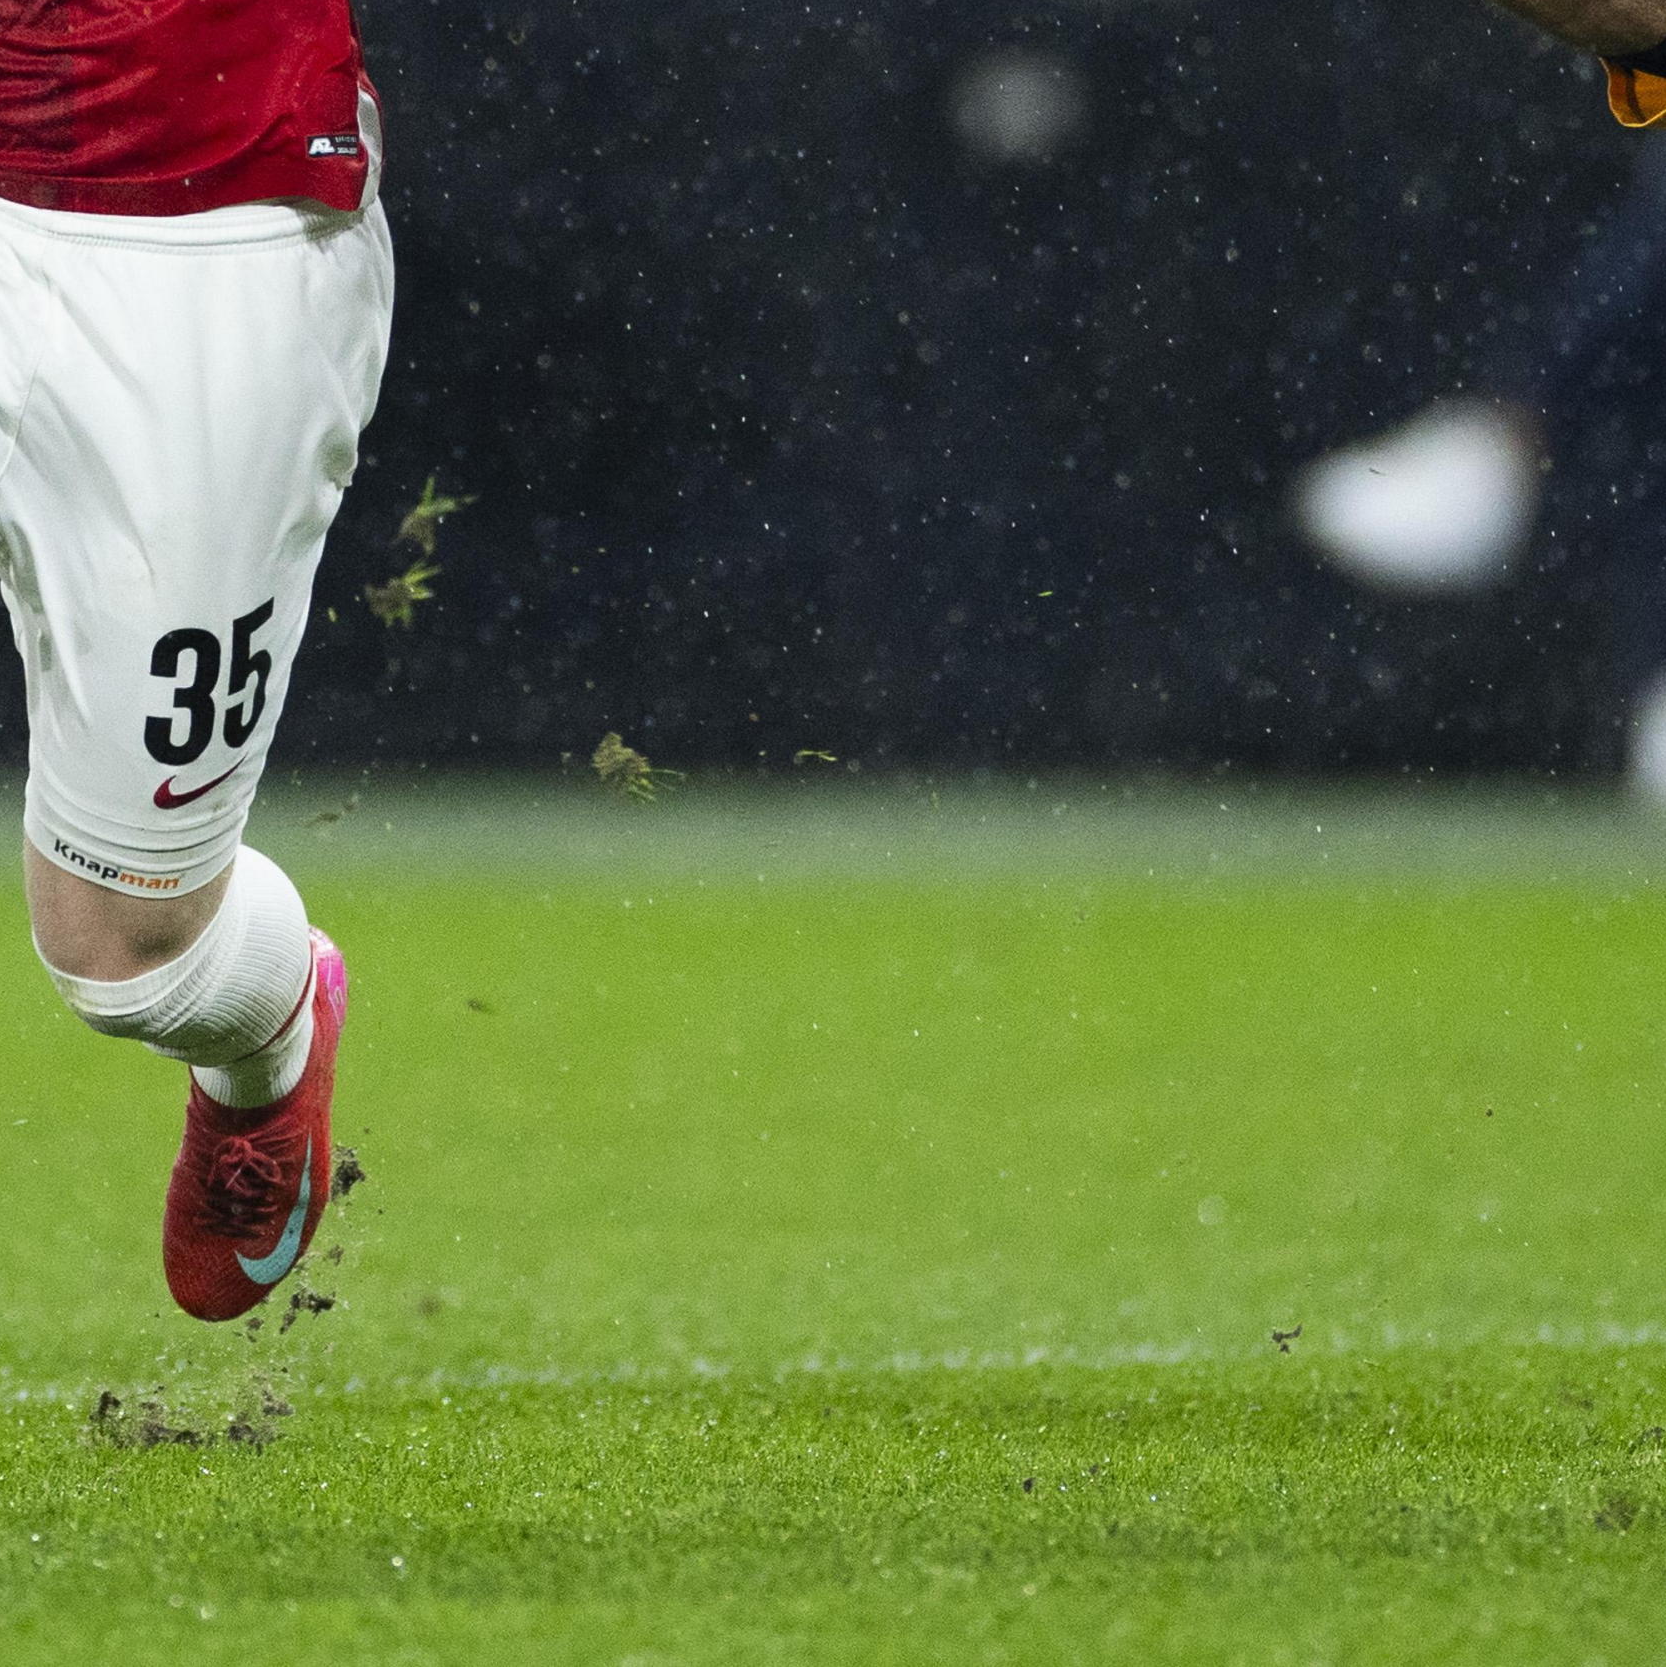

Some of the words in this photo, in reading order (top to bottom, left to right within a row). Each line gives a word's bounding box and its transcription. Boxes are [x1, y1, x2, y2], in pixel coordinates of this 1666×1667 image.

[308, 136, 335, 155] AZ
[144, 596, 275, 766] 35
[53, 838, 181, 890] Knapman
